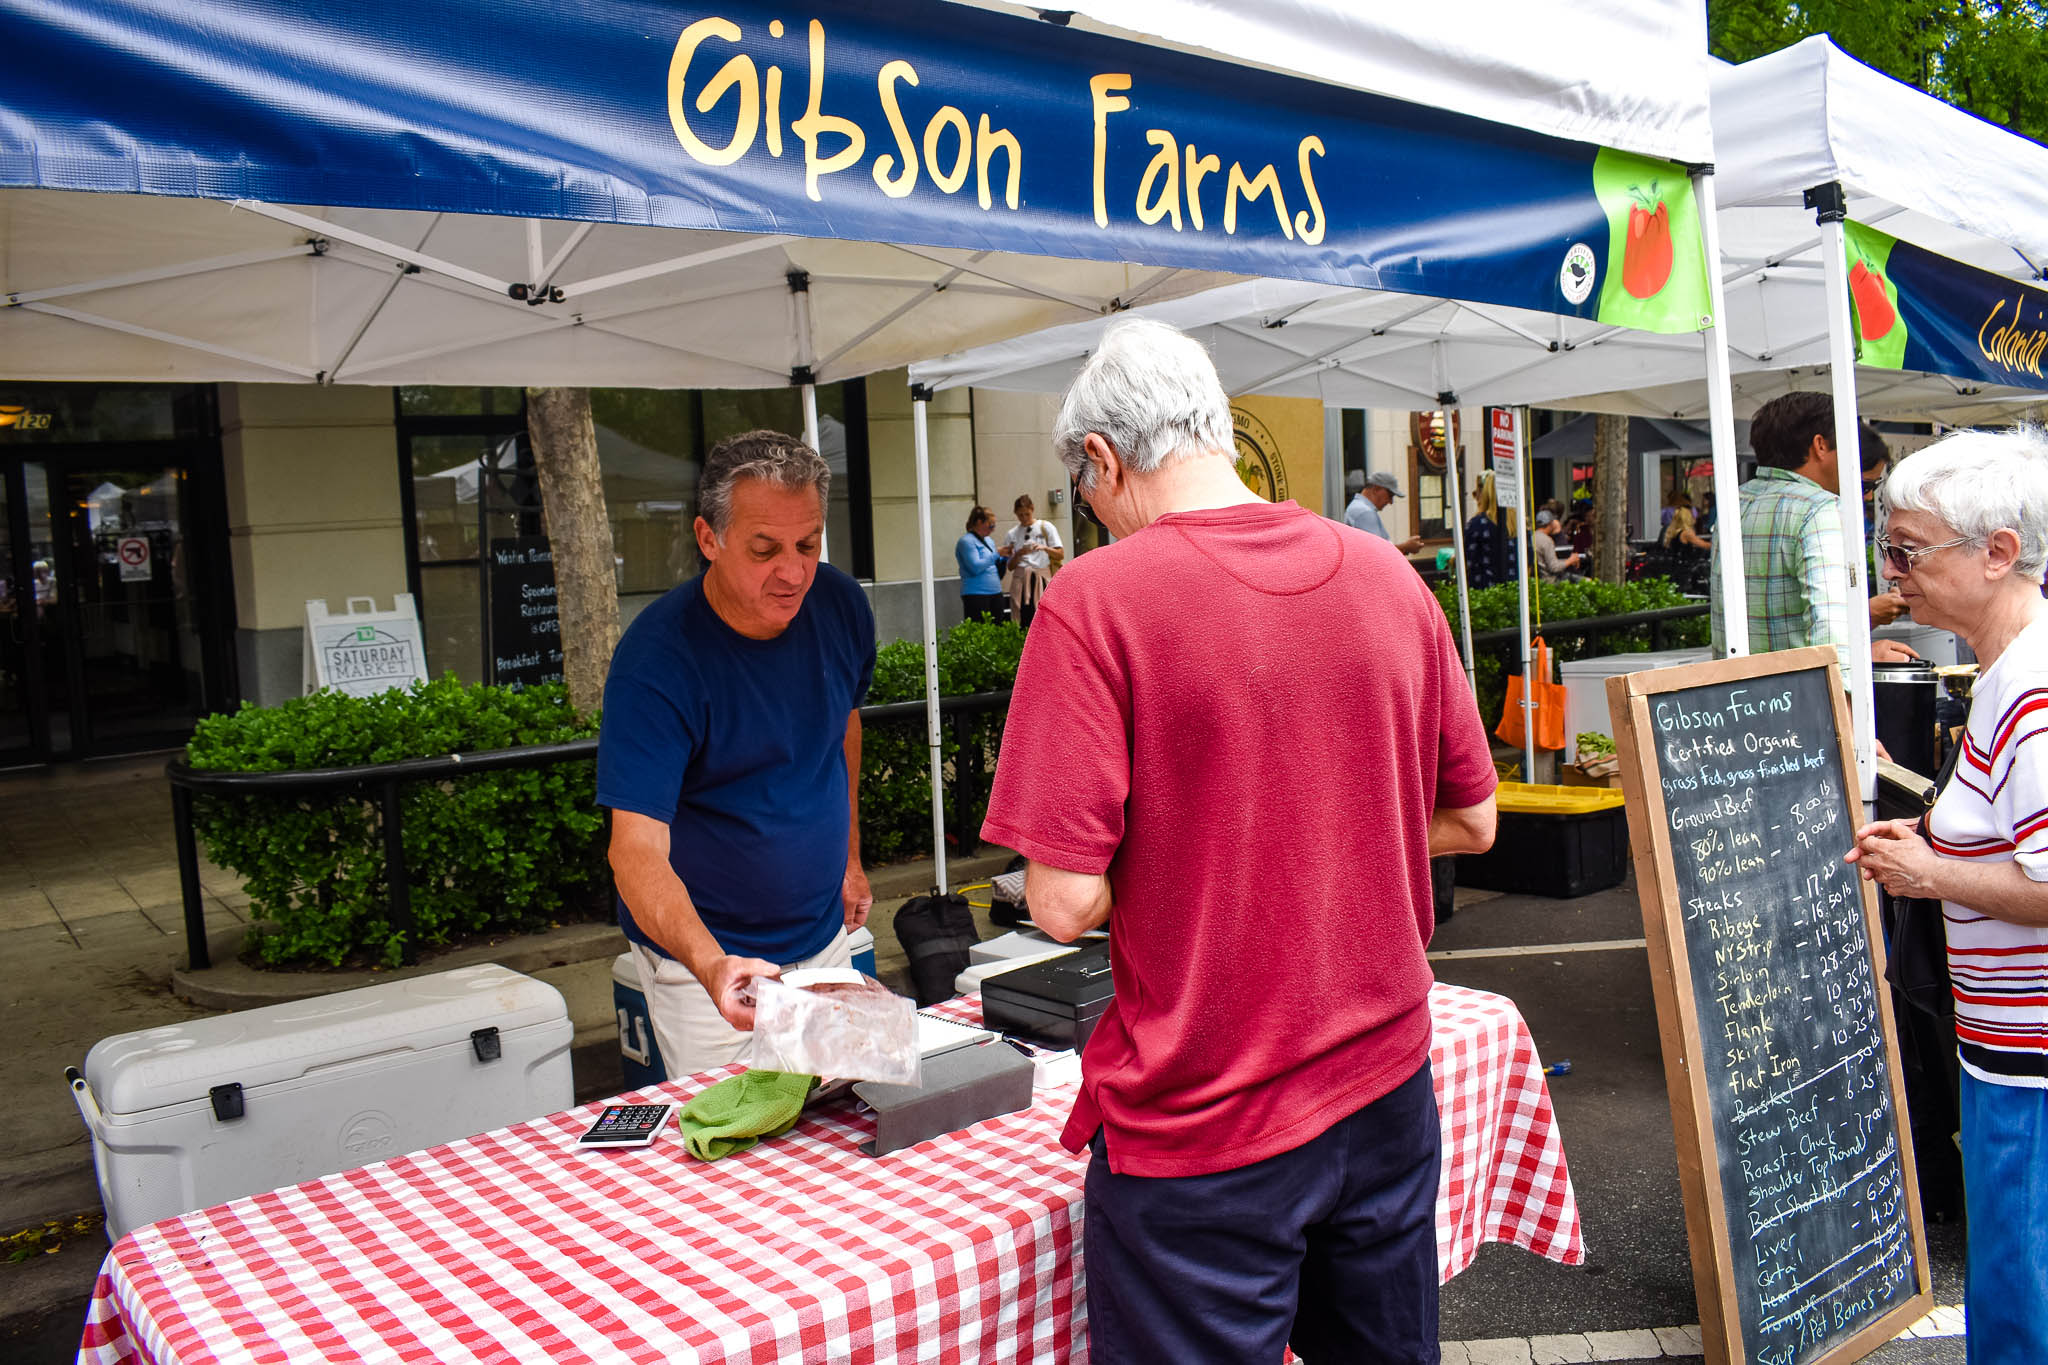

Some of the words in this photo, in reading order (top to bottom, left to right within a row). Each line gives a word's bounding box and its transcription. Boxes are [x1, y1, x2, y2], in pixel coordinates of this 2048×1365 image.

[667, 17, 1022, 211] Gibson
[1090, 73, 1326, 246] Farms
[20, 413, 50, 429] 120
[1500, 414, 1510, 428] NO
[1270, 452, 1284, 485] STONE
[333, 646, 405, 666] SATURDAY
[336, 660, 407, 679] MARKET
[496, 651, 541, 671] Breakfast
[1656, 700, 1724, 730] Gibson
[1726, 690, 1792, 721] Farms
[1667, 735, 1736, 762] Certified
[1744, 729, 1803, 754] Organic
[1662, 776, 1698, 798] grass
[1727, 768, 1755, 787] grass
[1803, 749, 1825, 768] beef
[1671, 799, 1723, 829] Ground
[1723, 787, 1754, 815] Beef
[1691, 829, 1724, 861] 80%
[1729, 827, 1761, 848] lean
[1699, 859, 1732, 883] 90%
[1736, 855, 1765, 873] lean
[1688, 889, 1743, 920] Steaks
[1708, 913, 1761, 939] Ribeye
[1717, 966, 1769, 991] Sirloin
[1716, 981, 1792, 1017] Tenderloin
[1724, 1009, 1774, 1042] Flank
[1726, 1036, 1772, 1067] Skirt
[1770, 1054, 1801, 1077] Iron
[1738, 1126, 1781, 1156] Stew
[1786, 1093, 1818, 1132] Beef
[1808, 1156, 1829, 1179] Top
[1755, 1233, 1797, 1267] Liver
